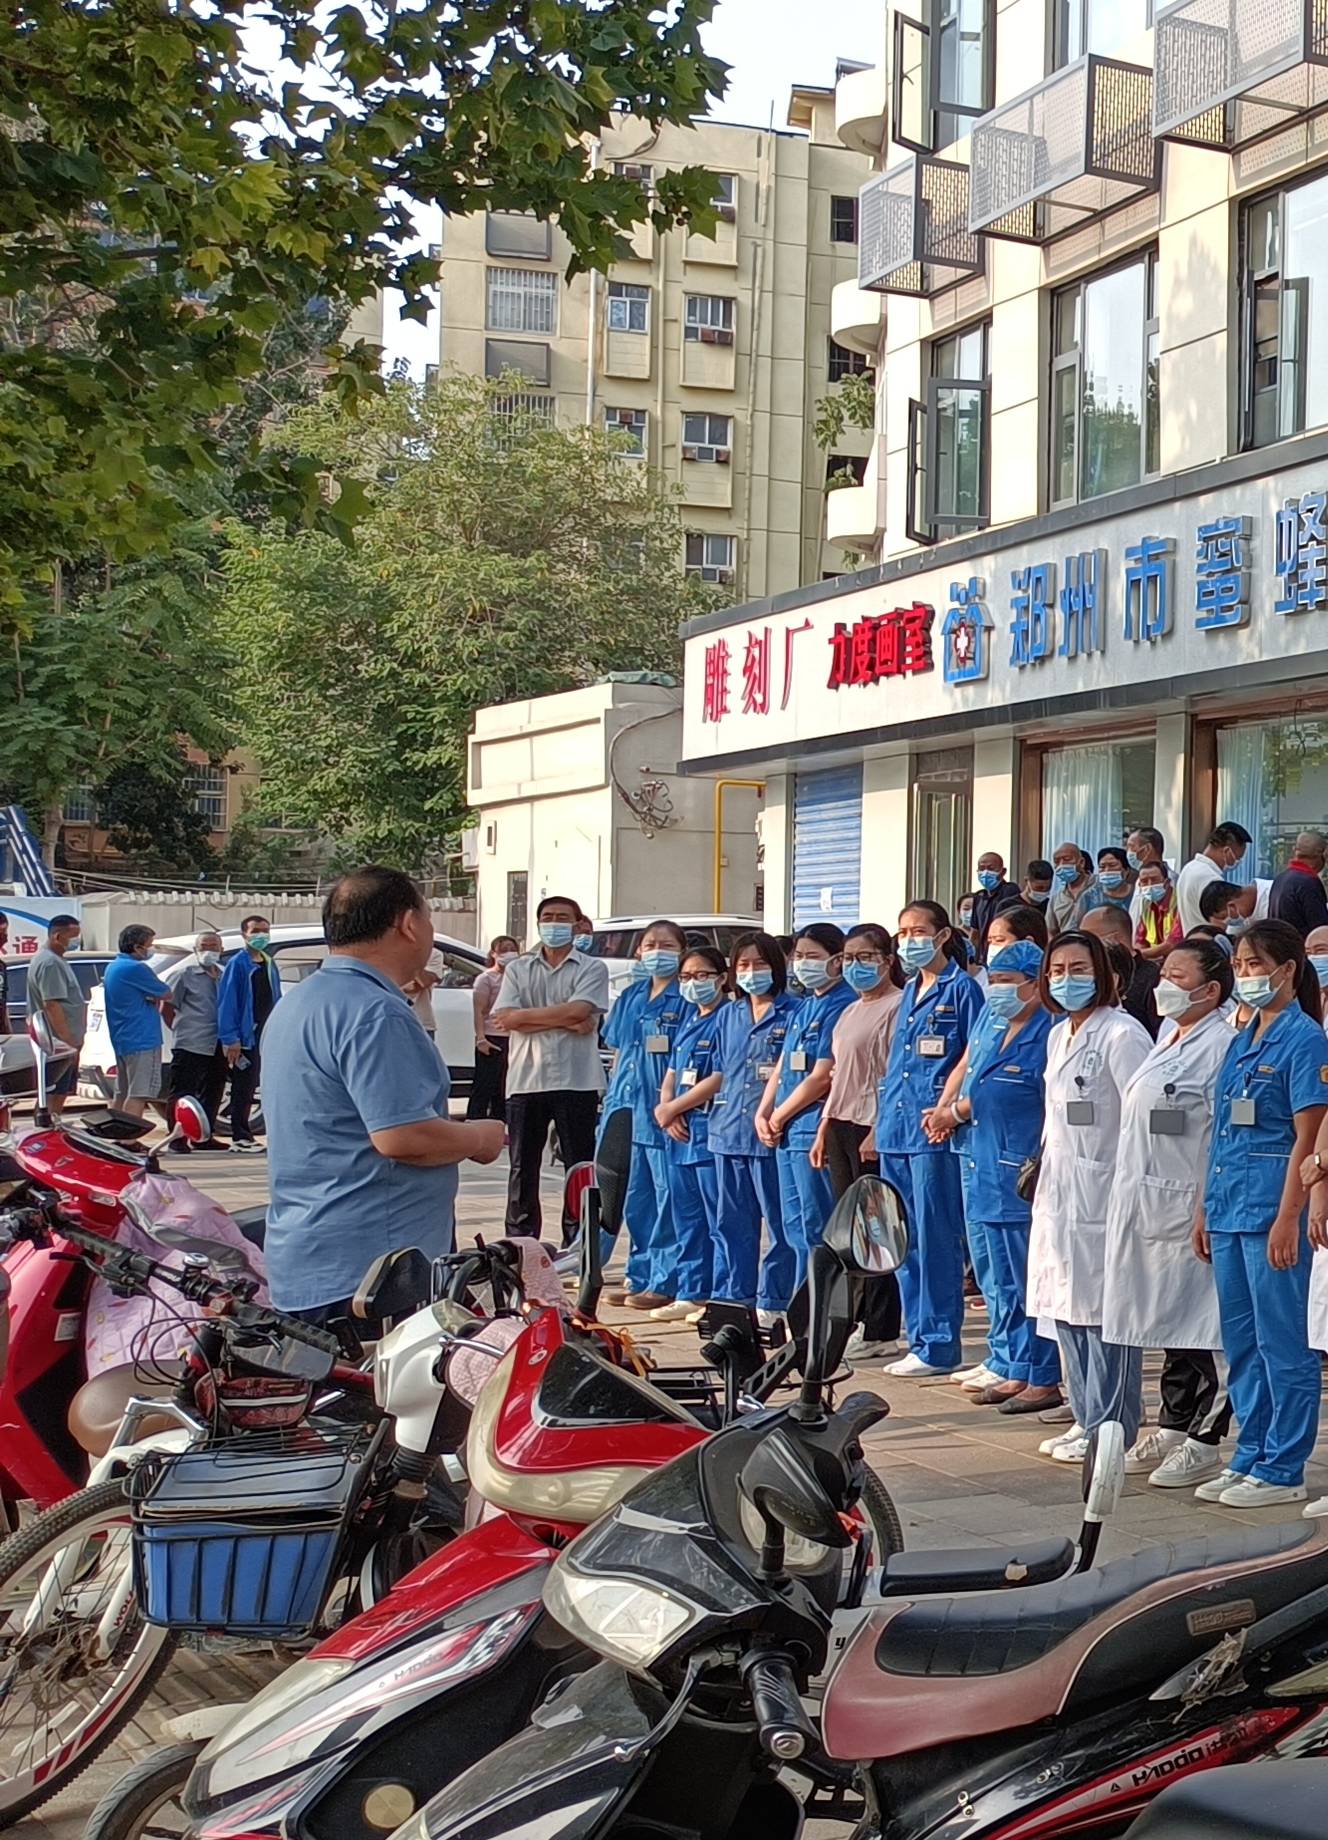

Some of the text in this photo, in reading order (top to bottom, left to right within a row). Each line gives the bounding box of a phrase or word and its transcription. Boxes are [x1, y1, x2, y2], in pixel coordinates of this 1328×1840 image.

[702, 617, 814, 724] 雕刻厂
[827, 601, 936, 690] 力度画室
